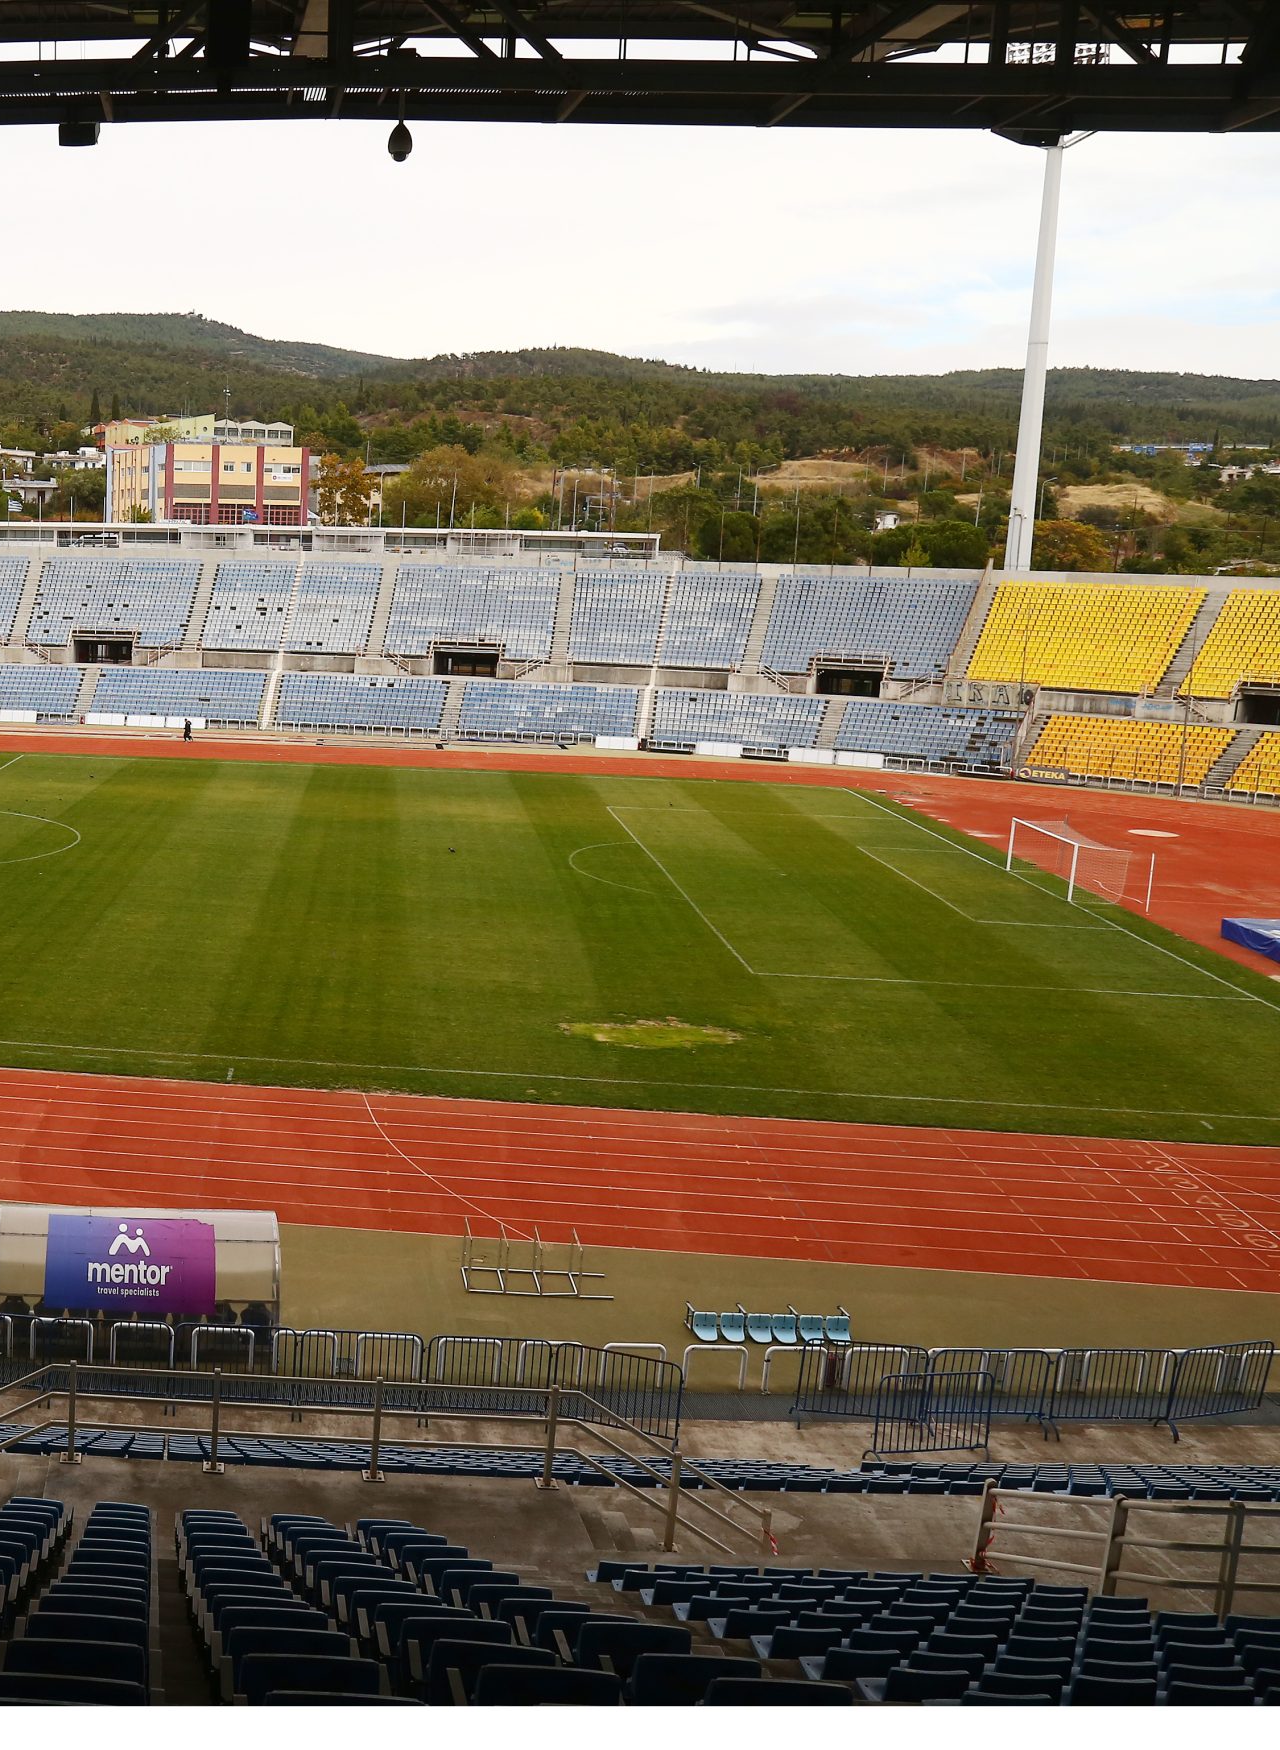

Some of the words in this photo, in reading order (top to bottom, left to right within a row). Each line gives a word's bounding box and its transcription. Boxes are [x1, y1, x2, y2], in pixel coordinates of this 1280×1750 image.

[1031, 769, 1066, 780] ETEKA
[1145, 1160, 1179, 1173] 2
[1167, 1176, 1199, 1190] 3
[1196, 1195, 1223, 1208] 4
[1215, 1213, 1250, 1228] 5
[1243, 1233, 1278, 1249] 6
[87, 1260, 170, 1286] mentor
[97, 1286, 119, 1295] travel
[120, 1287, 160, 1298] specialists
